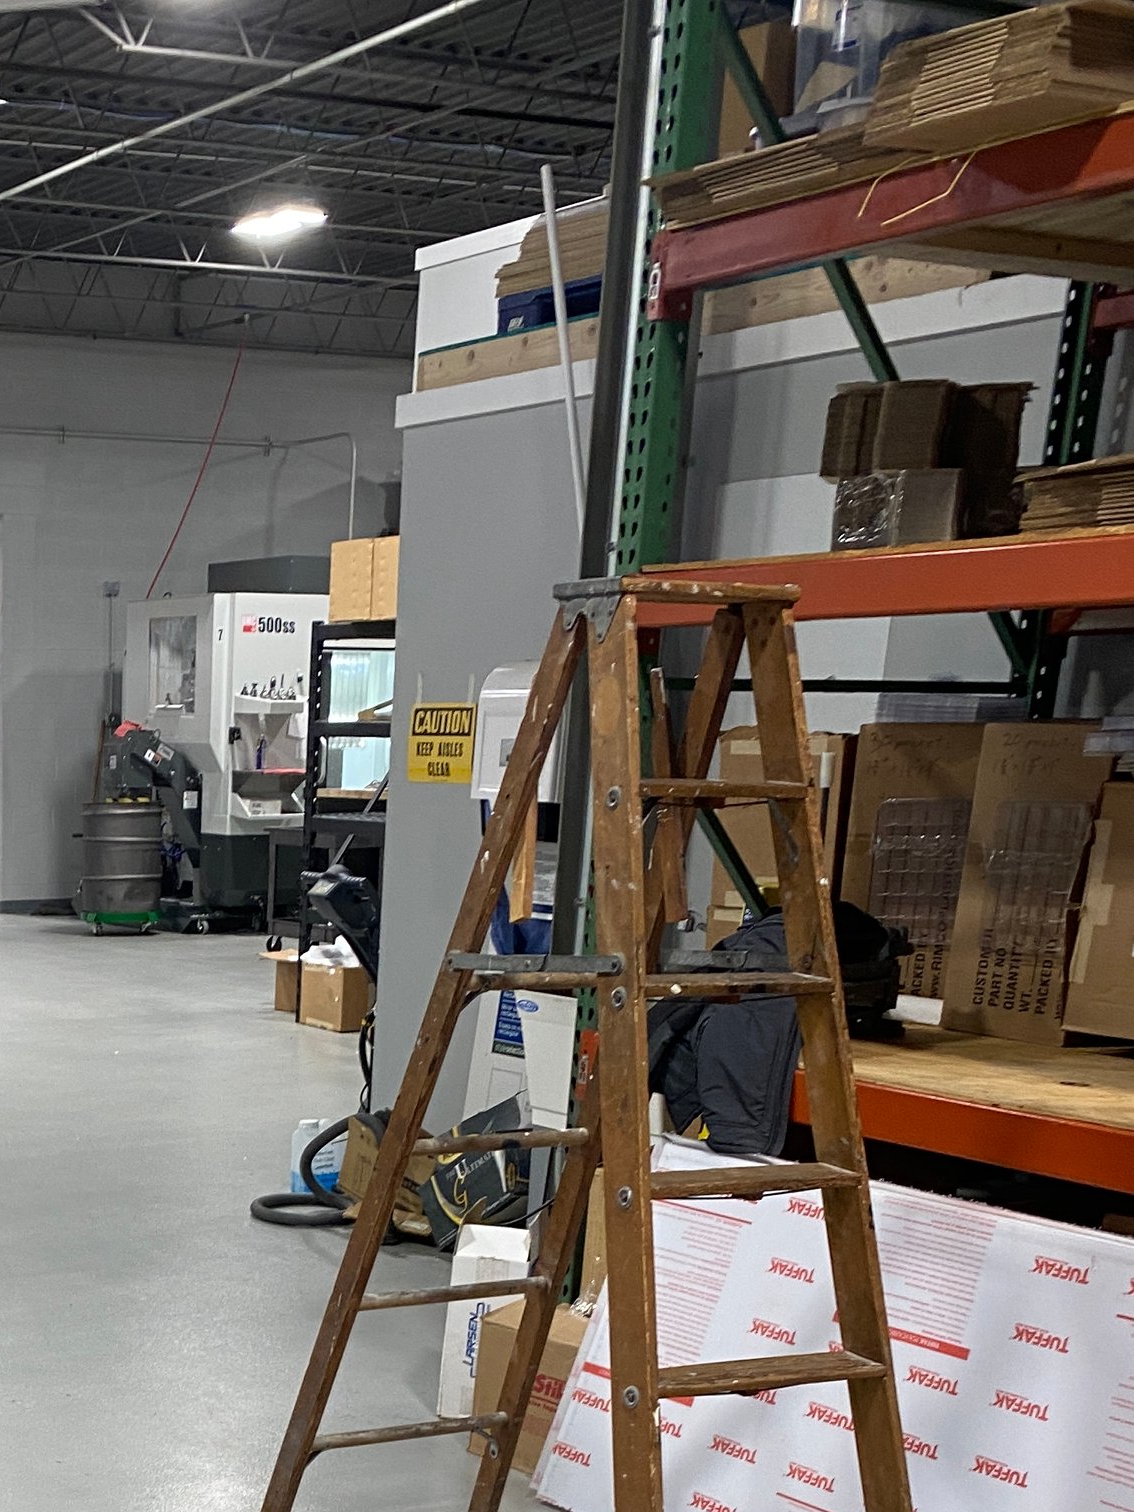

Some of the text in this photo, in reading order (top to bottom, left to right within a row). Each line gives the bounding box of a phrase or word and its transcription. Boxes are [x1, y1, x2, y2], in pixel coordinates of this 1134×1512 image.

[218, 629, 224, 641] 7
[414, 710, 472, 734] CAUTION
[416, 742, 464, 757] KEEP AISLES
[427, 762, 451, 776] CLEAR
[911, 953, 925, 997] ACKED
[988, 970, 1003, 1007] PART
[1033, 959, 1053, 1015] PACKED
[787, 1199, 826, 1224] UFFAK
[768, 1259, 815, 1284] TUFFAK
[1033, 1258, 1090, 1285] TUFFAK
[462, 1311, 481, 1368] LARSEN
[750, 1321, 796, 1346] TUFFAK
[1013, 1326, 1070, 1354] TUFFAK
[906, 1368, 959, 1396] TUFFAK
[806, 1403, 855, 1432] TUFFAK
[993, 1392, 1050, 1422] TUFFAK
[711, 1436, 758, 1465] TUFFAK
[786, 1464, 836, 1493] TUFFAK
[973, 1458, 1029, 1489] TUFFAK
